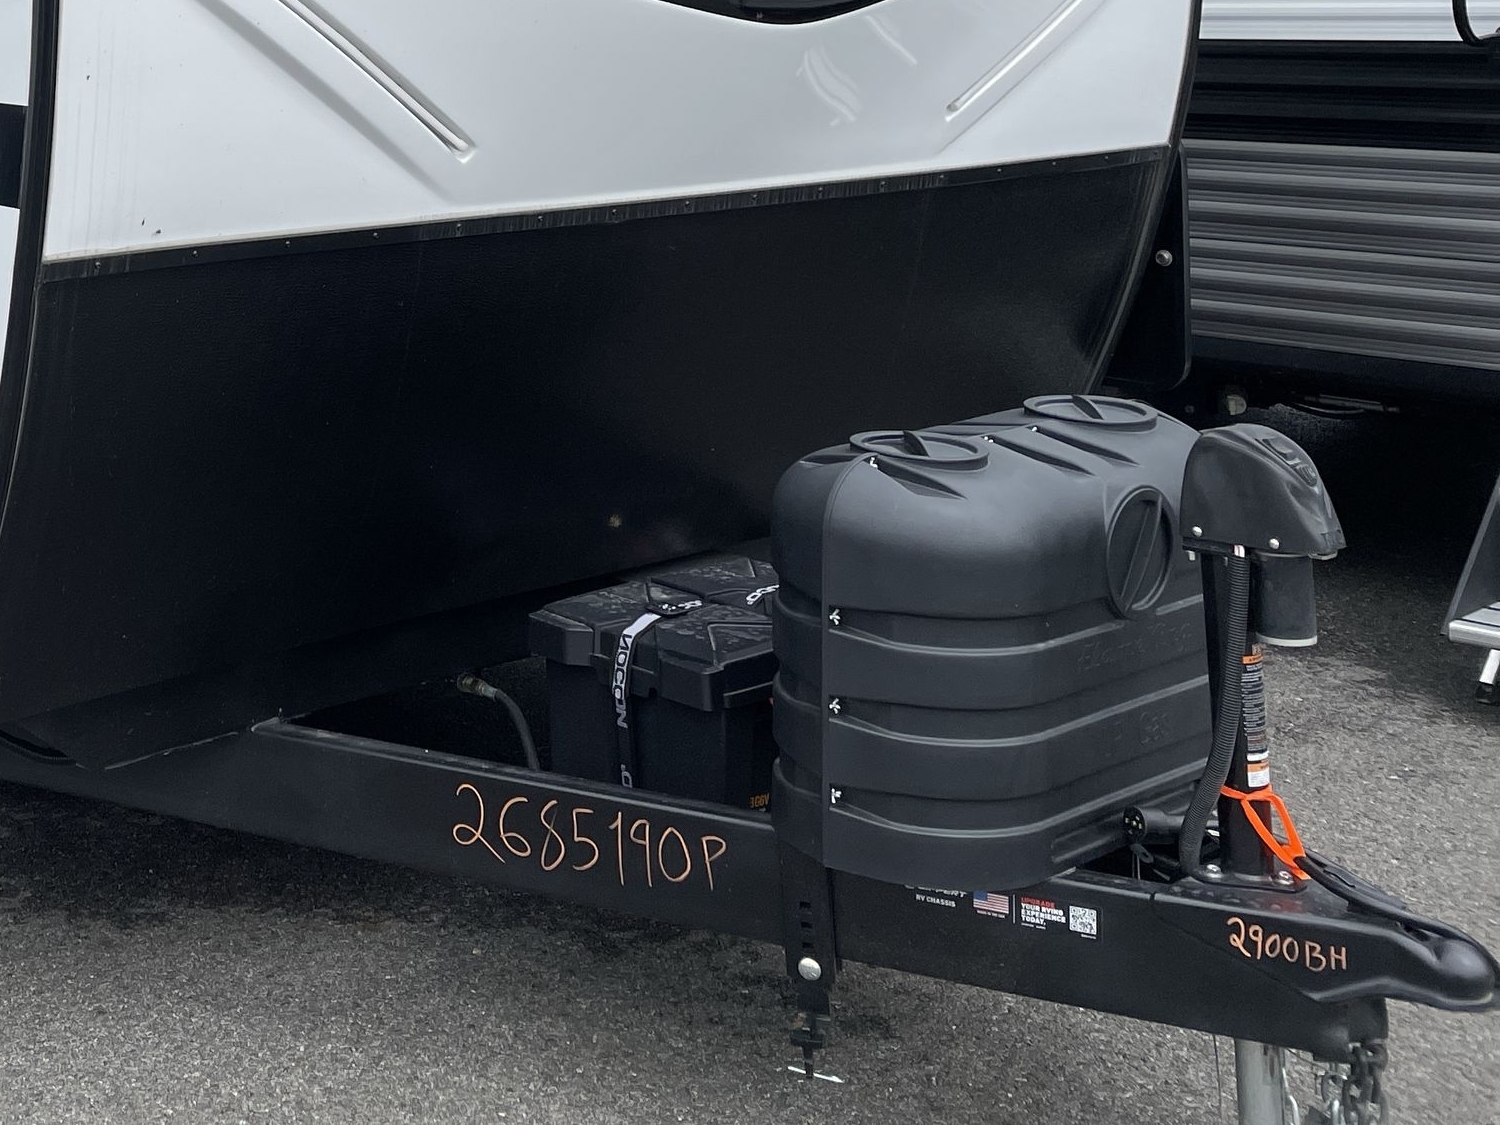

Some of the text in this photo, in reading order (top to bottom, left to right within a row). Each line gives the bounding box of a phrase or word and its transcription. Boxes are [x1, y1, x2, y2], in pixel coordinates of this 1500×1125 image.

[452, 782, 728, 891] 2685190P
[915, 893, 956, 908] RV CHASSIS
[1021, 902, 1041, 912] YOUR
[1021, 908, 1066, 924] EXPERIENCE
[1226, 916, 1348, 972] 2900BH
